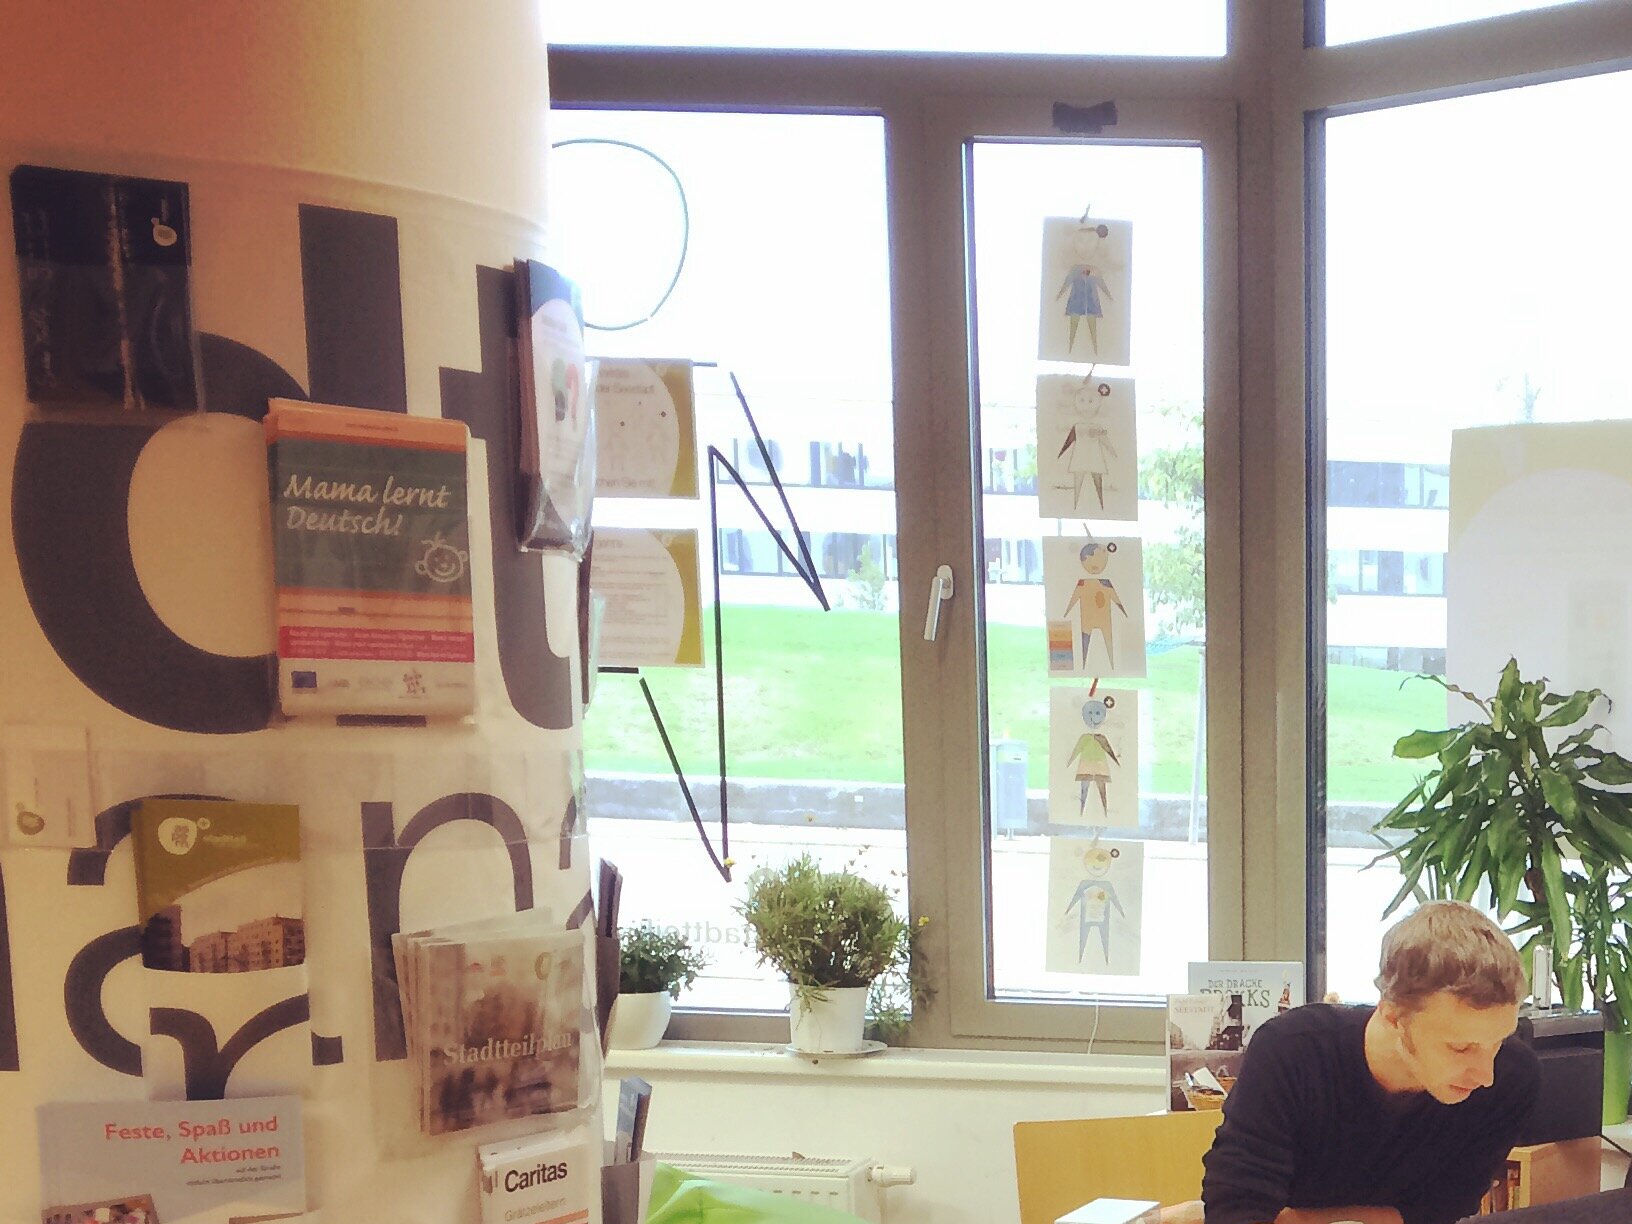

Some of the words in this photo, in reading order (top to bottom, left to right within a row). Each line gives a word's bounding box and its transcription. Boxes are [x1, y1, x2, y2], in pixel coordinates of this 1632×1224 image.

[283, 474, 378, 504] Mama
[383, 475, 451, 509] lernt
[286, 505, 403, 536] Deutsch!
[1208, 980, 1225, 989] DER
[1226, 979, 1263, 989] DRACHE
[105, 1123, 172, 1142] Feste,
[178, 1119, 231, 1142] Spaß
[239, 1116, 278, 1134] und
[181, 1146, 280, 1165] Aktionen
[504, 1162, 568, 1193] Caritas
